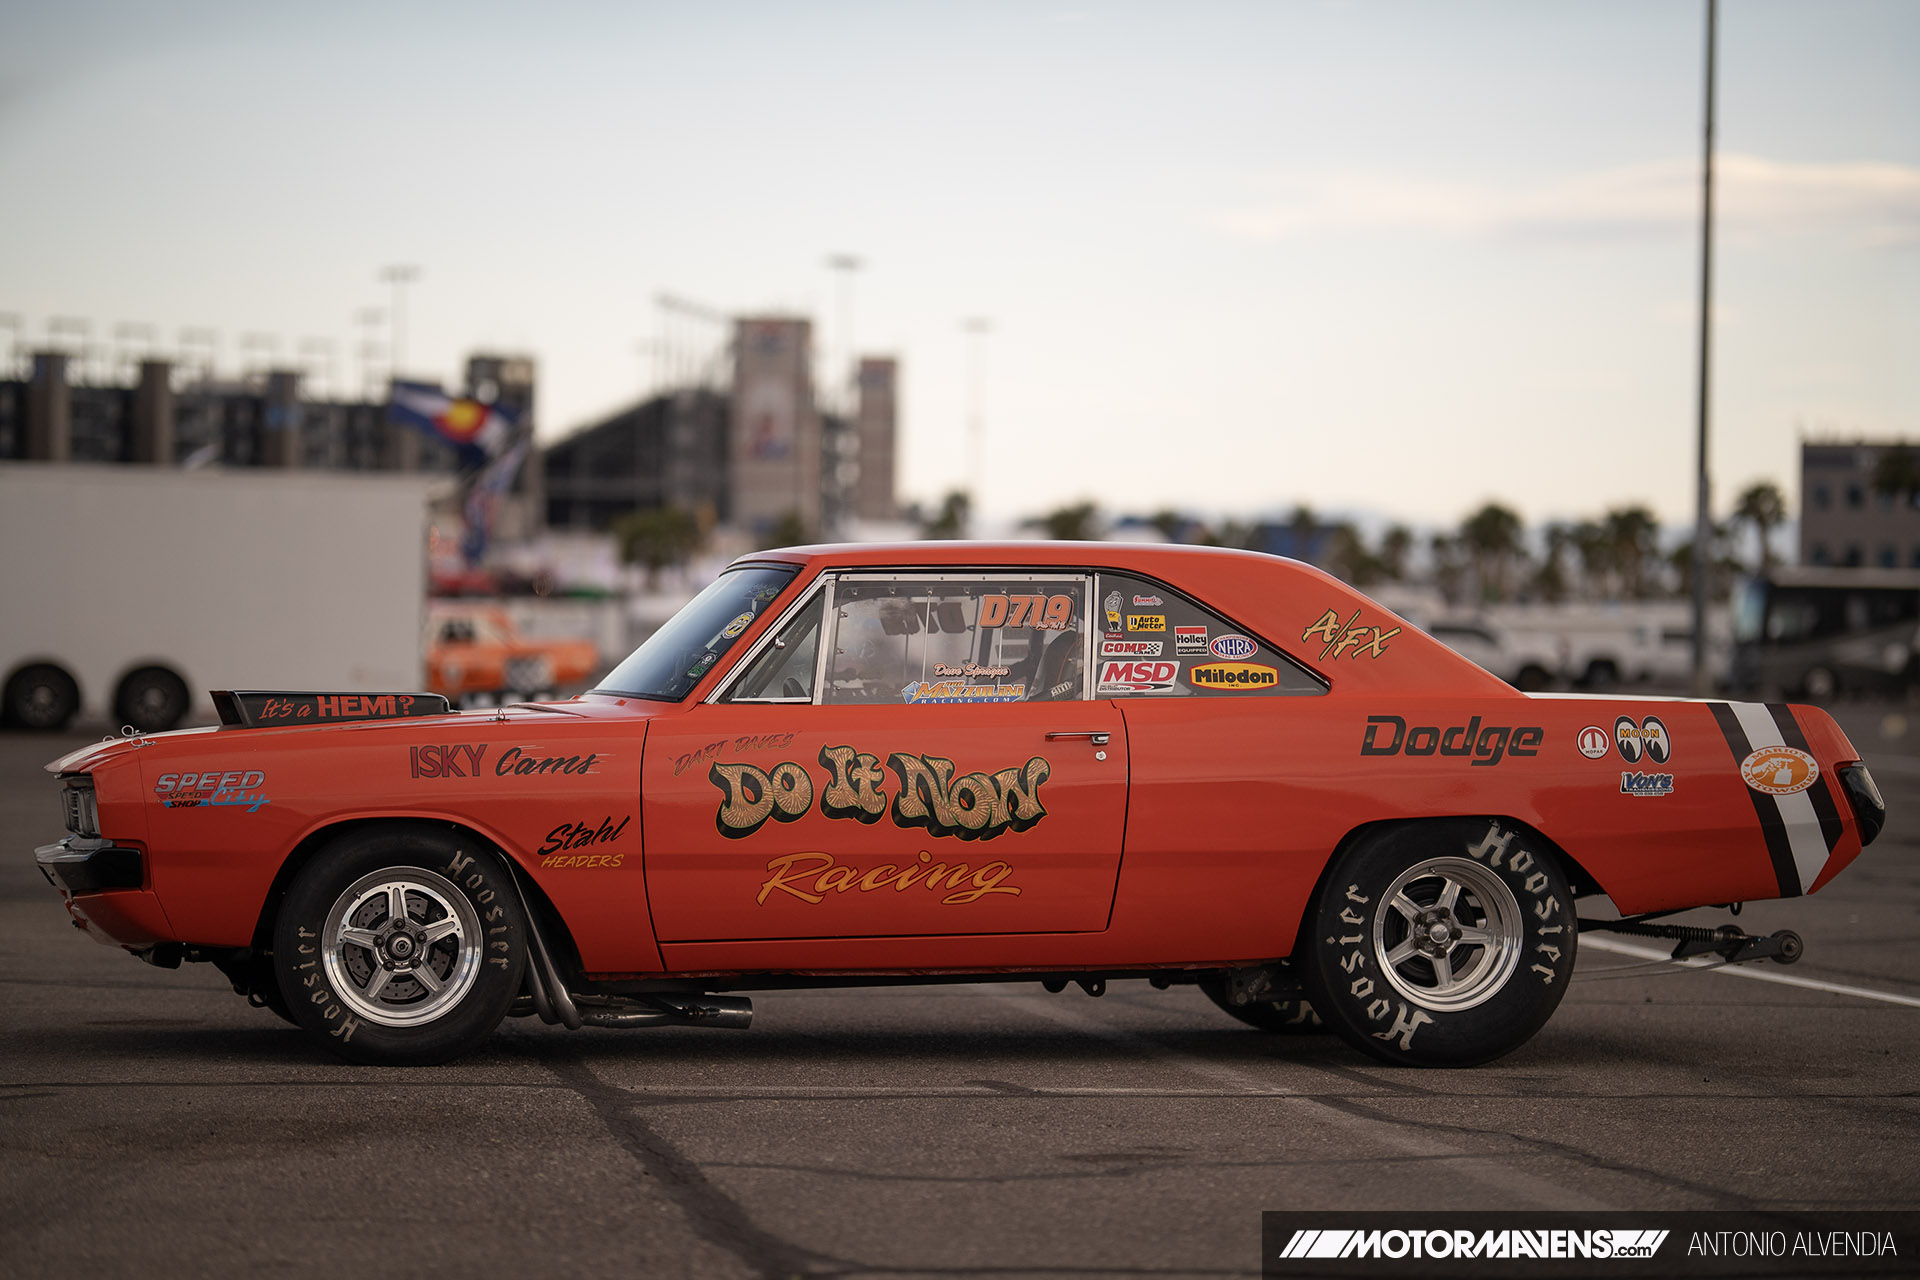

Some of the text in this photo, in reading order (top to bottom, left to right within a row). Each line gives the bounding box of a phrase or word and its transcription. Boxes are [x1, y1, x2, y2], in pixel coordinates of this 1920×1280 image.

[979, 594, 1074, 629] D719
[1176, 635, 1206, 645] Holley
[1301, 608, 1401, 661] A/FX
[1104, 643, 1148, 652] COMP
[1218, 639, 1251, 655] NHRA
[934, 662, 1011, 679] Dave Sprague
[1103, 662, 1176, 682] MSD
[1195, 669, 1274, 683] Milodon
[259, 698, 295, 719] It's
[297, 707, 312, 718] a
[1360, 716, 1544, 766] Dodge
[1620, 728, 1660, 738] MOON
[410, 744, 600, 778] ISKY Cams
[1751, 748, 1808, 760] MARIO'S
[154, 770, 265, 792] SPEED
[818, 743, 887, 825] It
[1743, 770, 1817, 793] AUTOWORKS
[169, 800, 202, 808] SHOP
[210, 787, 270, 813] City
[537, 815, 631, 855] Stahl
[541, 854, 624, 868] HEADERS
[756, 850, 1022, 906] Racing
[438, 850, 514, 970] Hoosier
[1468, 818, 1574, 985] Hoosier
[1326, 883, 1435, 1051] Hoosier
[292, 926, 366, 1042] Hoosier
